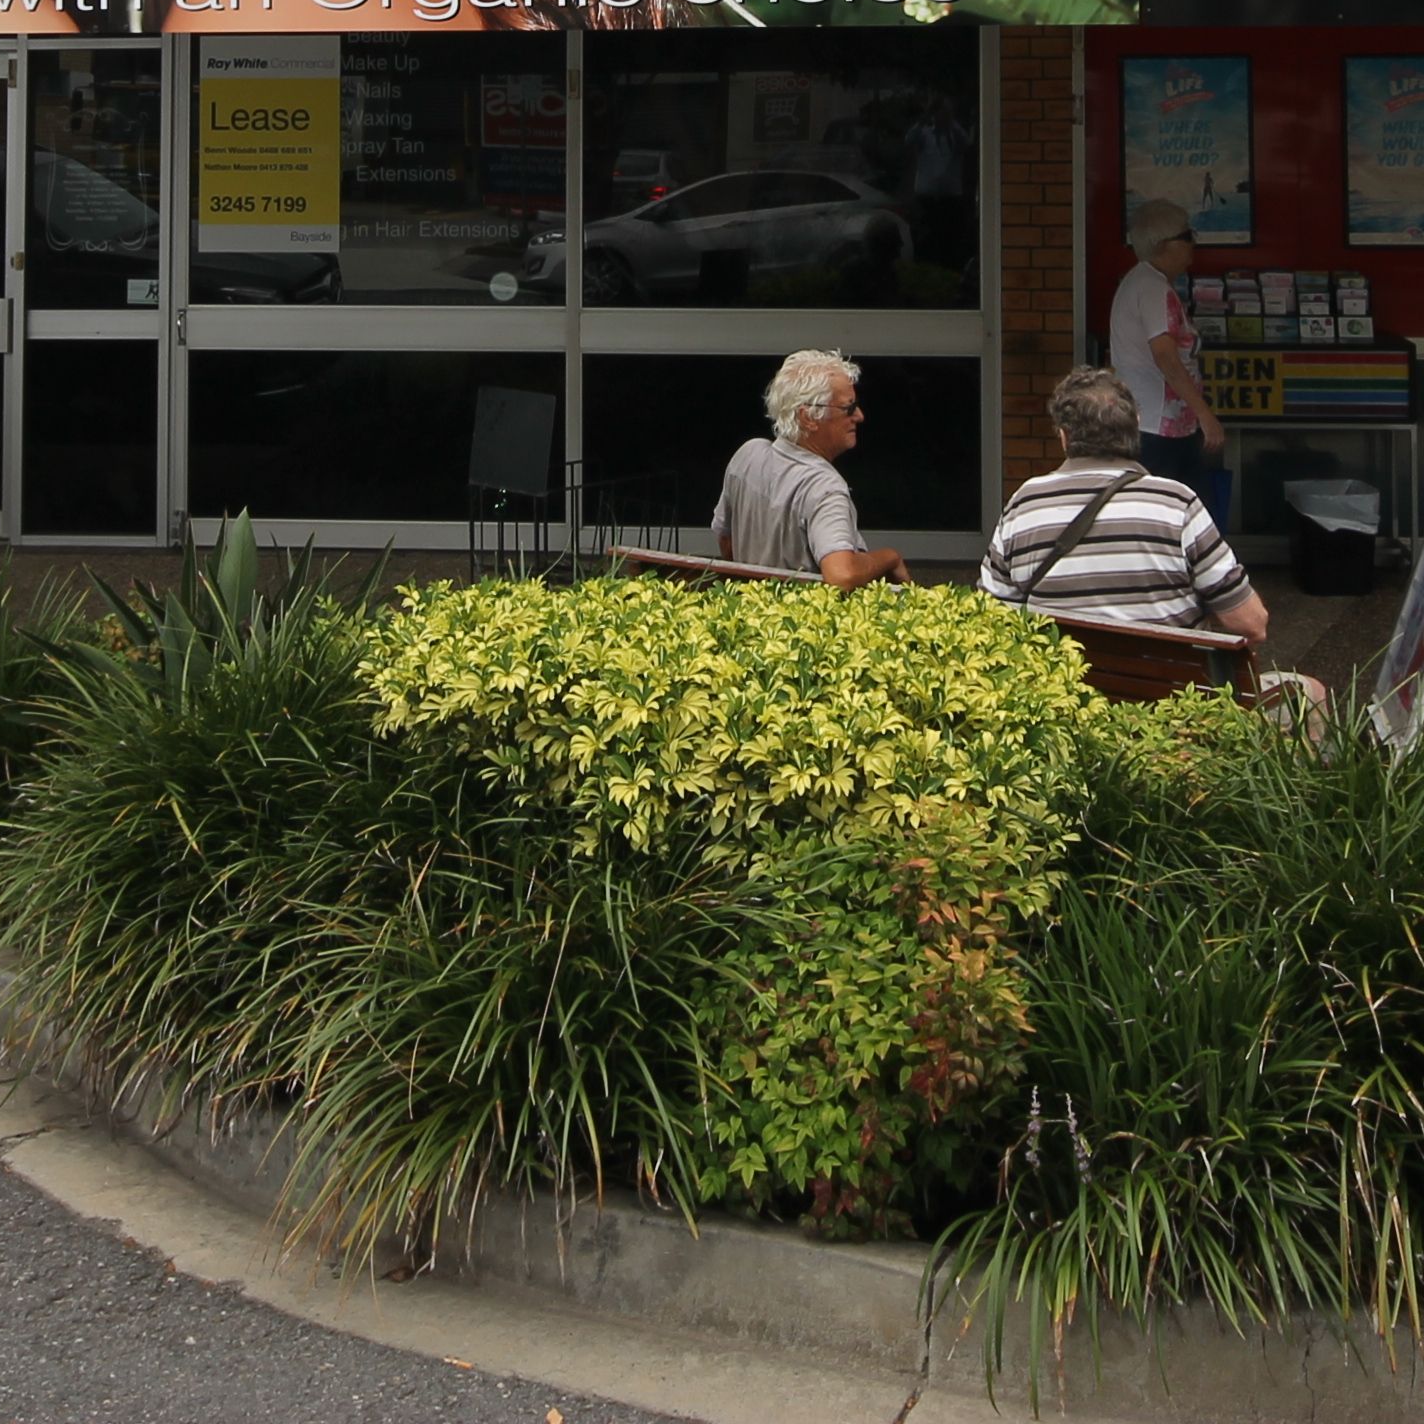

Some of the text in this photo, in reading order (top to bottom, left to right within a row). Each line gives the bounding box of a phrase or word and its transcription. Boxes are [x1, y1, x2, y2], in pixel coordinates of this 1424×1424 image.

[348, 31, 411, 48] Beauty
[206, 57, 335, 71] Ray White Commercial
[341, 54, 421, 76] Make Up
[356, 81, 402, 98] Nails
[210, 101, 311, 132] Lease
[344, 109, 413, 131] Waxing
[1158, 120, 1213, 135] WHERE
[392, 136, 425, 154] Tan
[1158, 136, 1214, 151] WOULD
[1152, 153, 1220, 167] YOU GO?
[1376, 153, 1408, 167] YOU
[355, 164, 457, 183] Extensions
[210, 196, 308, 213] 3245 7199
[290, 230, 332, 243] Bayside
[353, 220, 369, 238] in
[375, 220, 413, 238] Hair
[418, 220, 521, 238] Extensions
[1198, 357, 1276, 381] LDEN
[1202, 385, 1273, 410] SKET
